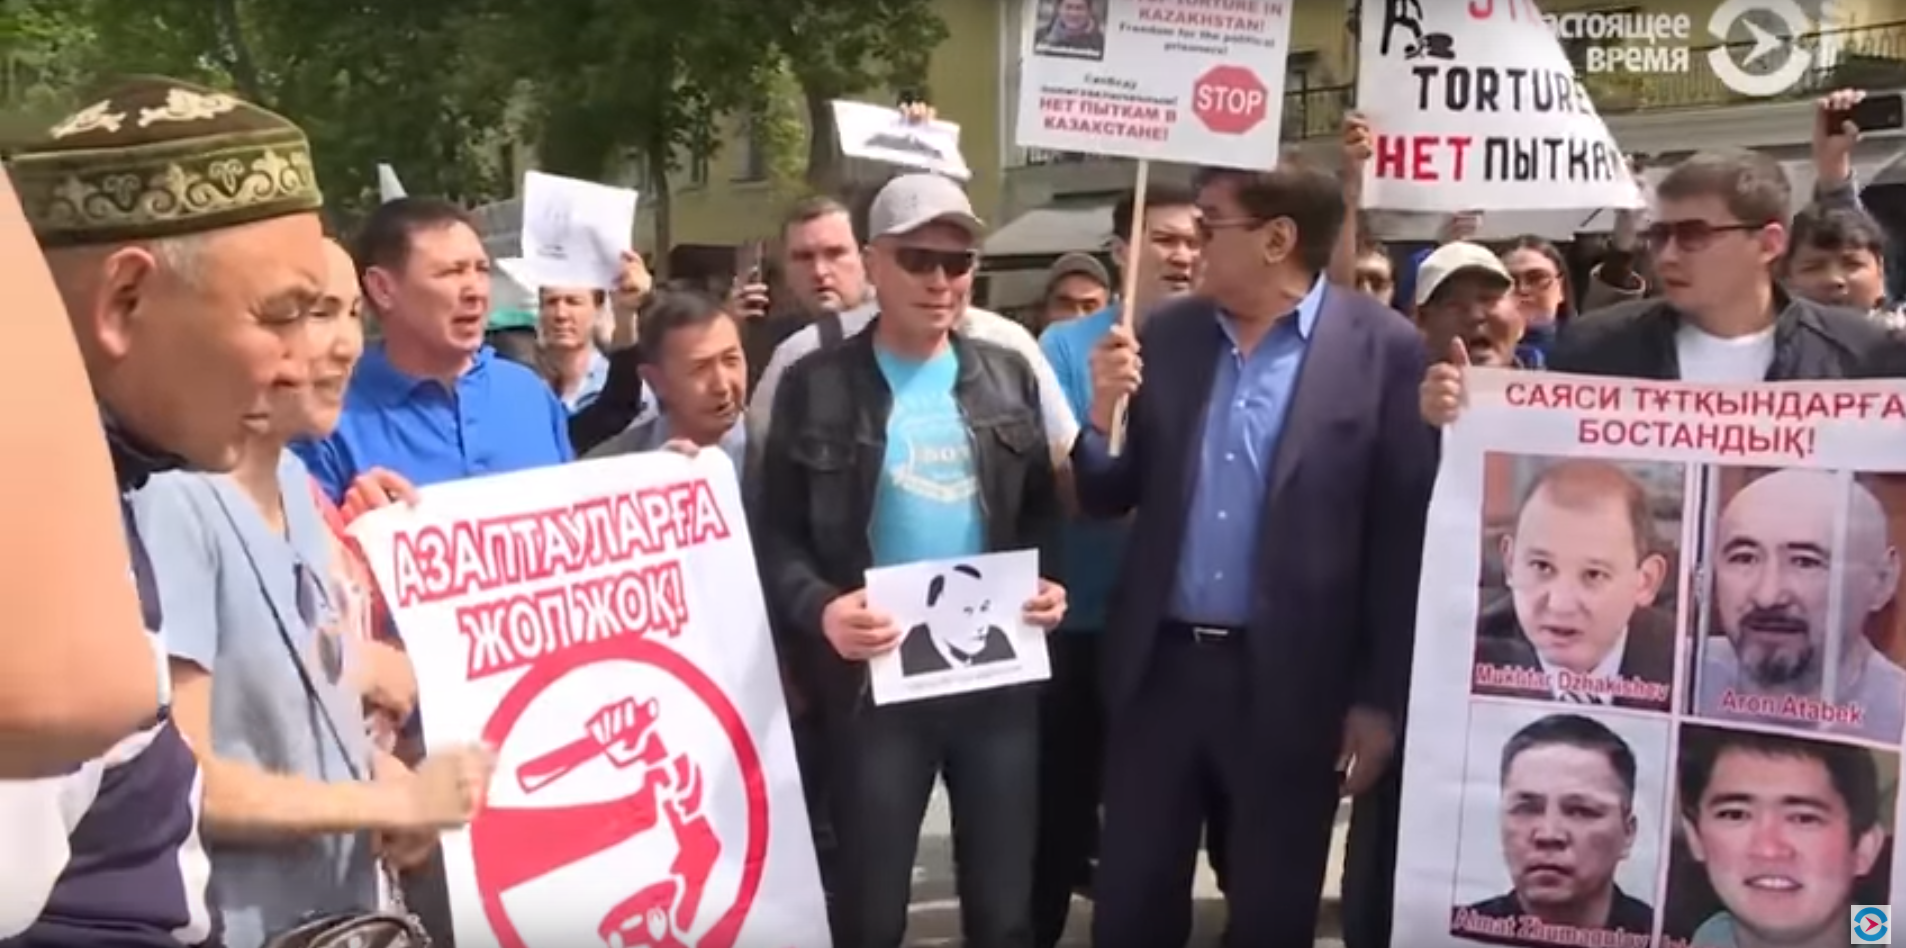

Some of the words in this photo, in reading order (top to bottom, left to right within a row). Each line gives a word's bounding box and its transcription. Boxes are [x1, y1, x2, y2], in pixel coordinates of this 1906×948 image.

[1138, 8, 1265, 32] KAZAKHSTAN!
[1264, 2, 1283, 16] IN
[1118, 21, 1174, 36] Freedom
[1178, 28, 1196, 39] for
[1199, 29, 1220, 41] the
[1223, 33, 1275, 48] political
[1039, 97, 1074, 113] НЕТ
[1079, 99, 1160, 120] ПЫТКАМ
[1165, 109, 1177, 123] В
[1197, 84, 1262, 115] STOP
[1043, 115, 1169, 141] КАЗАХСТАНЕ!
[1376, 136, 1473, 182] НЕТ
[1505, 383, 1622, 412] САЯСИ
[1578, 418, 1816, 458] БОСТАНДЫҚ!
[394, 479, 731, 608] АЗАПТАУЛАРҒА
[572, 560, 688, 644] ЖОҚ!
[1475, 662, 1551, 688] Mukhtar
[1558, 670, 1671, 702] Dzhakishov
[1721, 687, 1775, 714] Aron
[1781, 695, 1864, 724] Atabek
[1452, 907, 1516, 938] Almat
